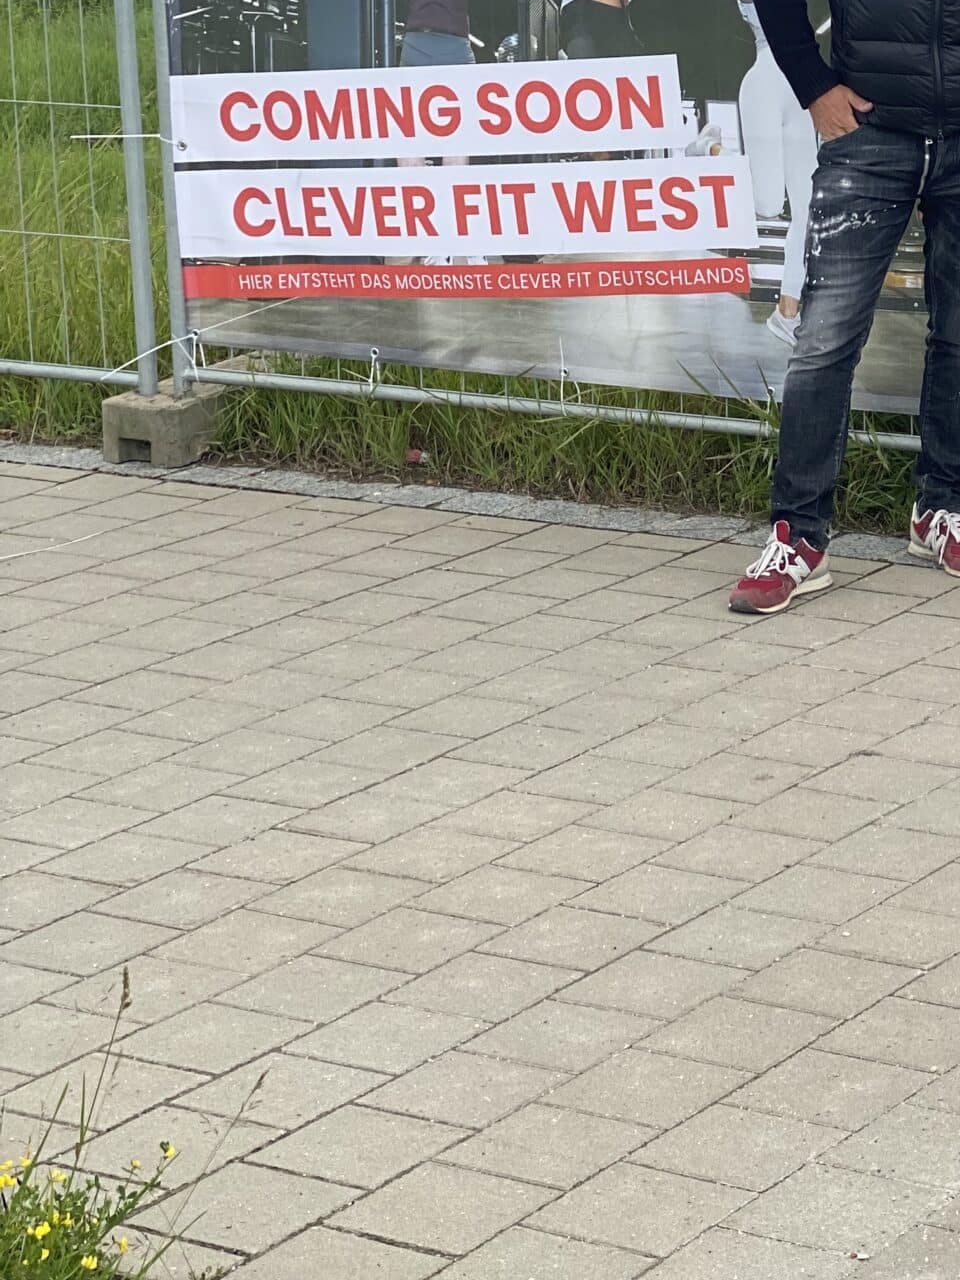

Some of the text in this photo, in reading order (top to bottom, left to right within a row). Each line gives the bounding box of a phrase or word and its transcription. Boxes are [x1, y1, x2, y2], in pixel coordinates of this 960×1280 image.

[220, 75, 664, 142] COMING SOON
[233, 175, 735, 238] CLEVER FIT WEST
[239, 267, 745, 290] HIER ENTSTEHT DAS MODERNSTE CLEVER FIT DEUTSCHLANDS
